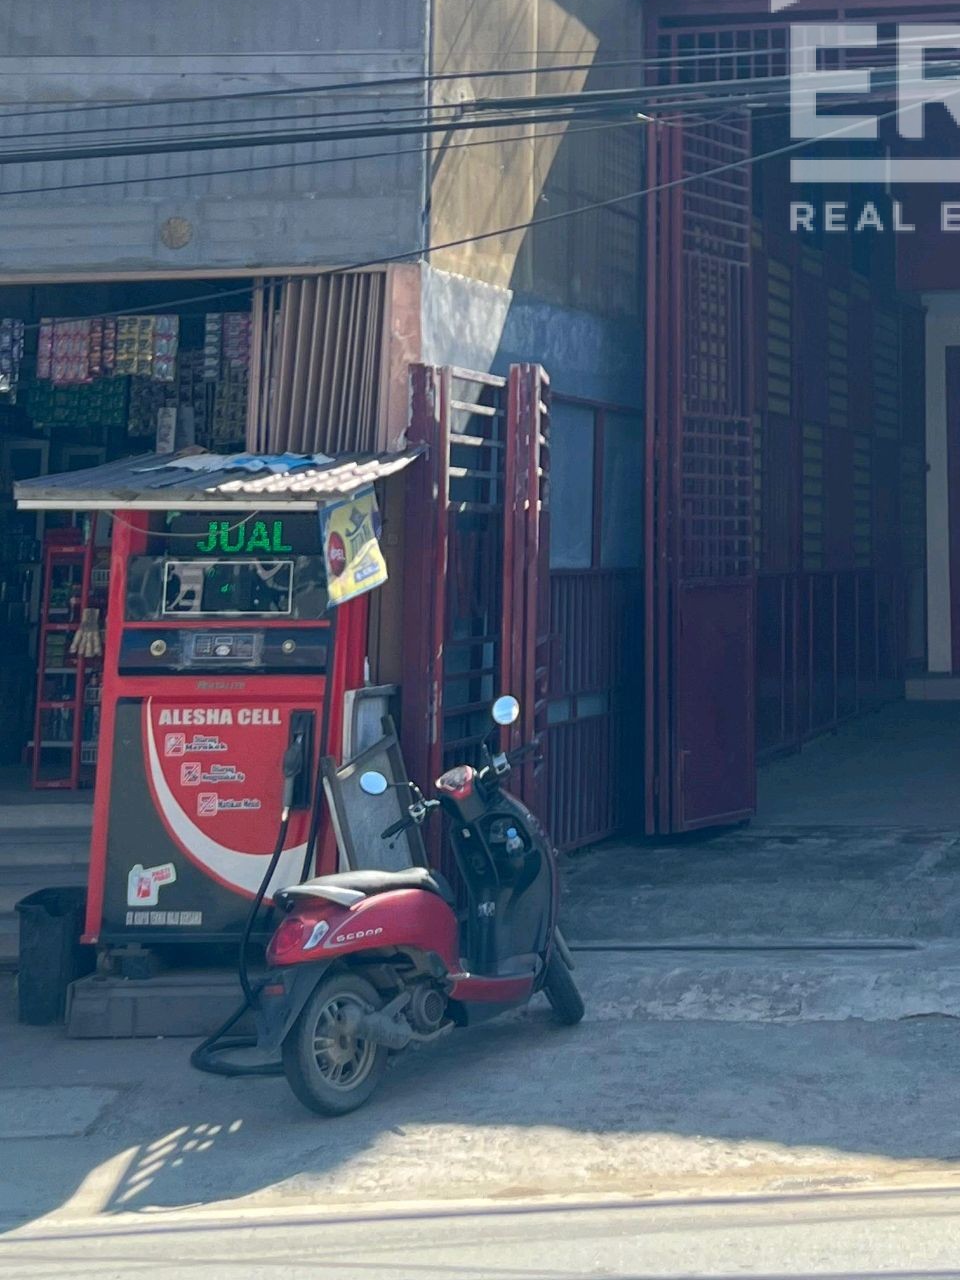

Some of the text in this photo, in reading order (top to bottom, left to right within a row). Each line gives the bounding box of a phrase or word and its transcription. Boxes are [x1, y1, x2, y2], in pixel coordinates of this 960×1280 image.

[196, 521, 292, 552] JUAL
[158, 708, 282, 726] ALESHA CELL
